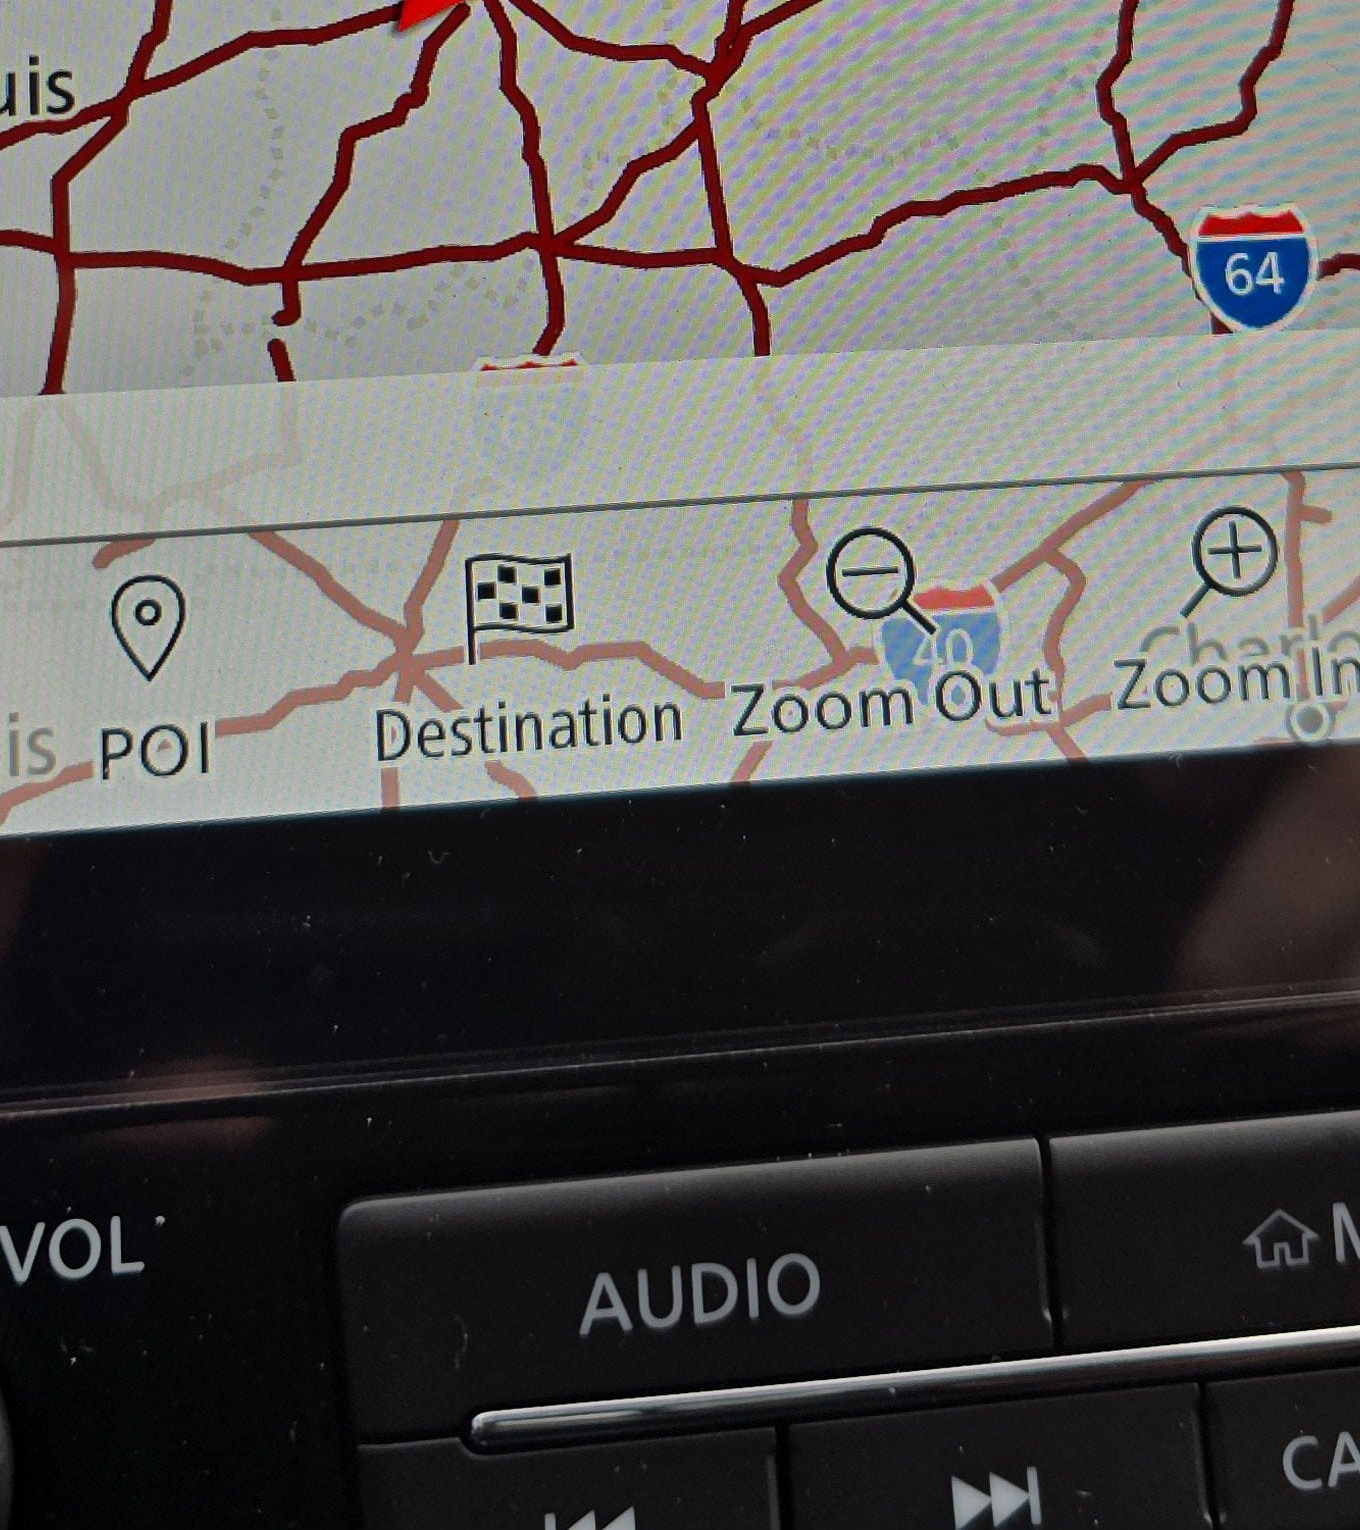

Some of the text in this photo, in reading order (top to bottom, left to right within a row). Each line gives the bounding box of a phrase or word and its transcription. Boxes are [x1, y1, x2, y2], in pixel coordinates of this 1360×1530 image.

[1223, 251, 1285, 297] 64
[912, 628, 974, 672] 40
[731, 668, 1052, 738] Zoom Out
[1114, 657, 1291, 710] Zoom
[100, 721, 210, 781] POI
[376, 692, 683, 762] Destination
[578, 1252, 823, 1339] AUDIO
